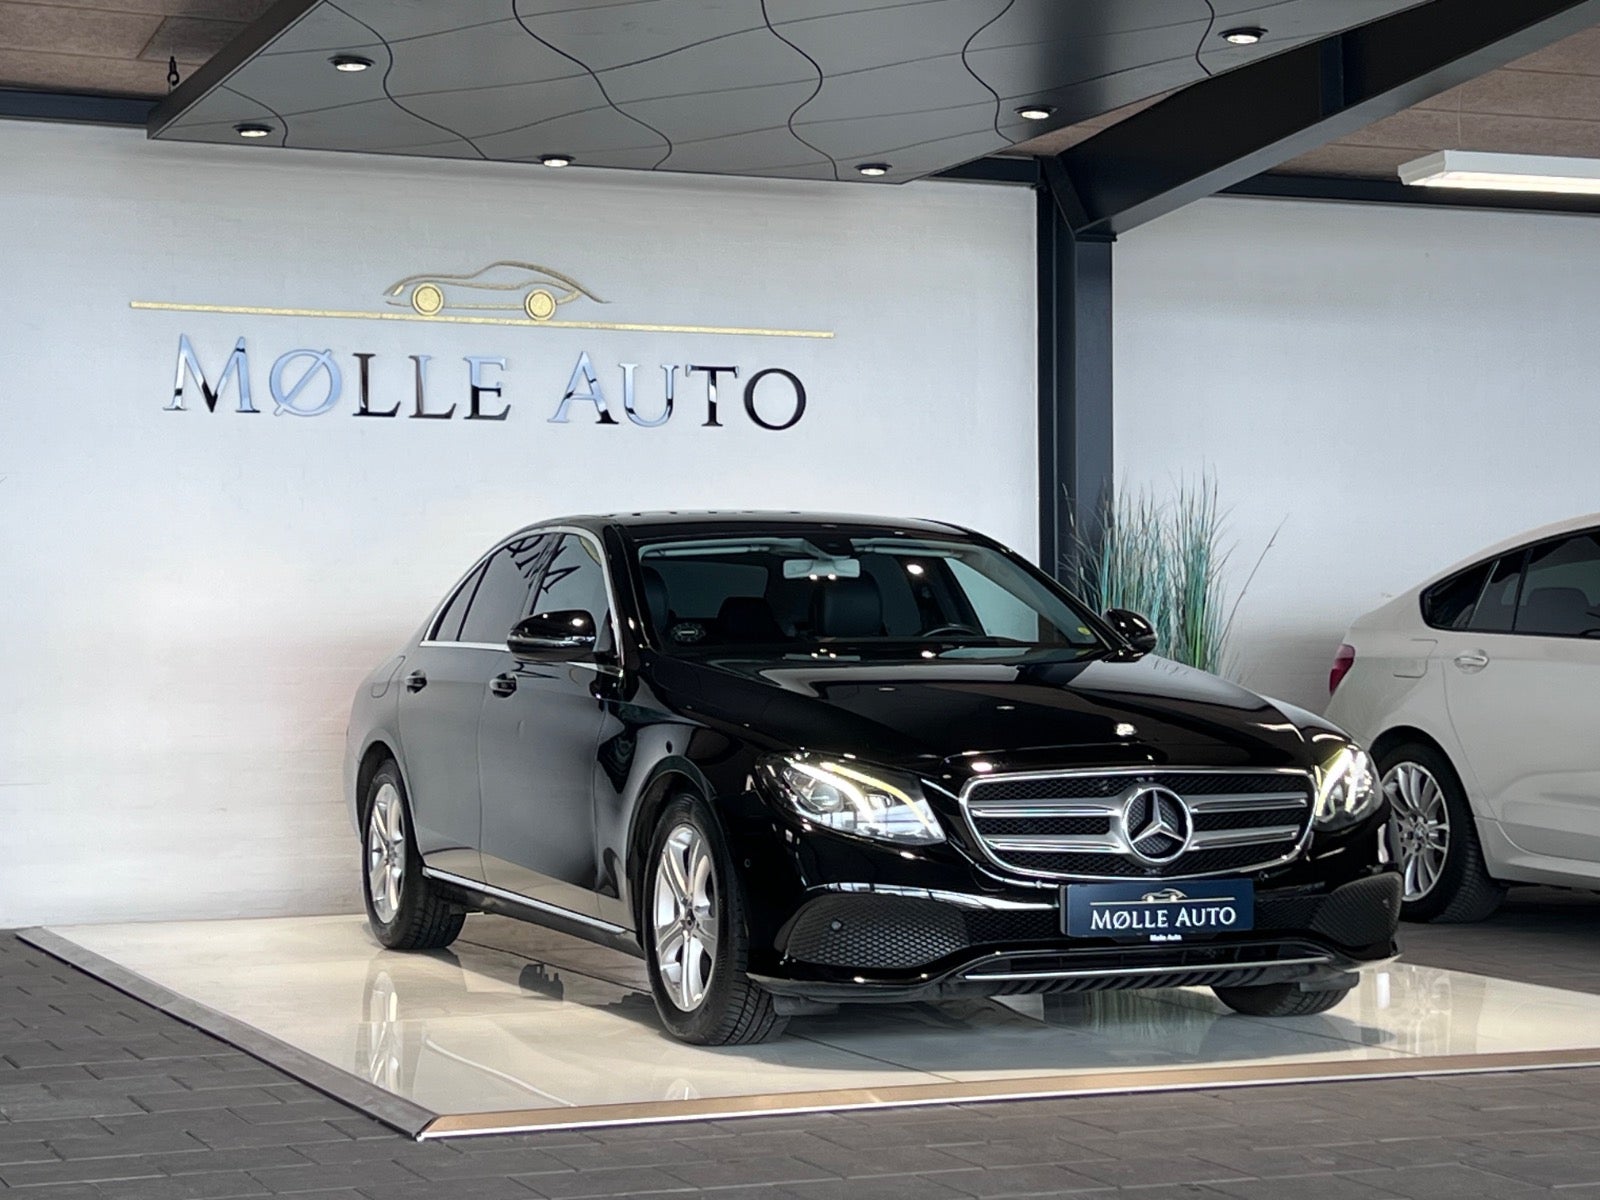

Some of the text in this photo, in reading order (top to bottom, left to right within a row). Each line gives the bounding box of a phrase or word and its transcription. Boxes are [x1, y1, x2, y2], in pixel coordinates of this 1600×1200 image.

[162, 332, 808, 431] MØLLE AUTO
[1090, 906, 1237, 930] MØLLE AUTO
